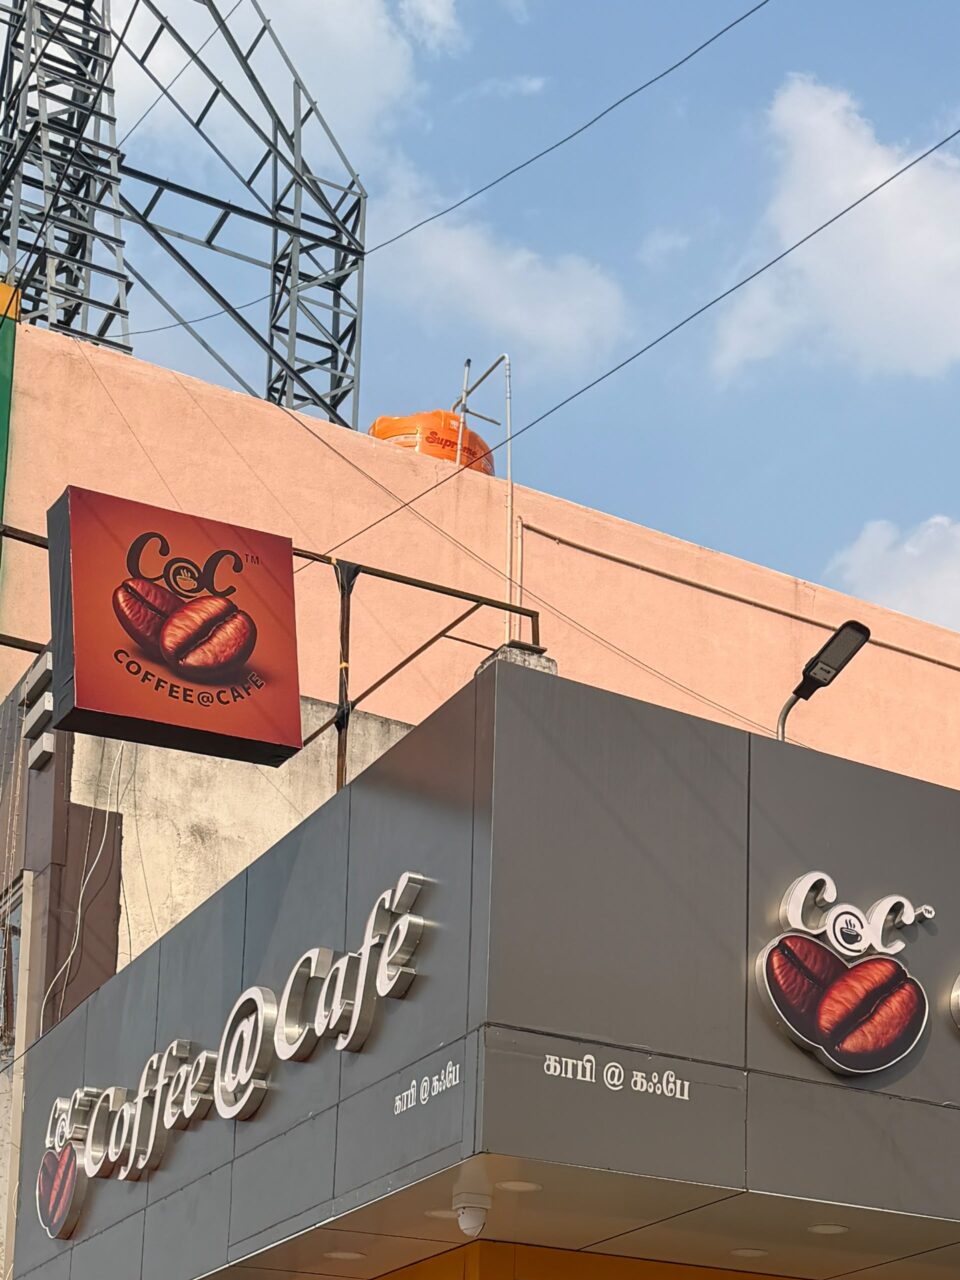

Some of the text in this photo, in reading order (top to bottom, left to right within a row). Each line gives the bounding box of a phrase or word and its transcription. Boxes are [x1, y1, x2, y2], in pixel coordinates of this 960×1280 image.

[425, 431, 478, 458] Suprme
[85, 1039, 217, 1179] Coffee
[274, 872, 424, 1061] Café
[543, 1054, 691, 1101] காபி @ கஃபே
